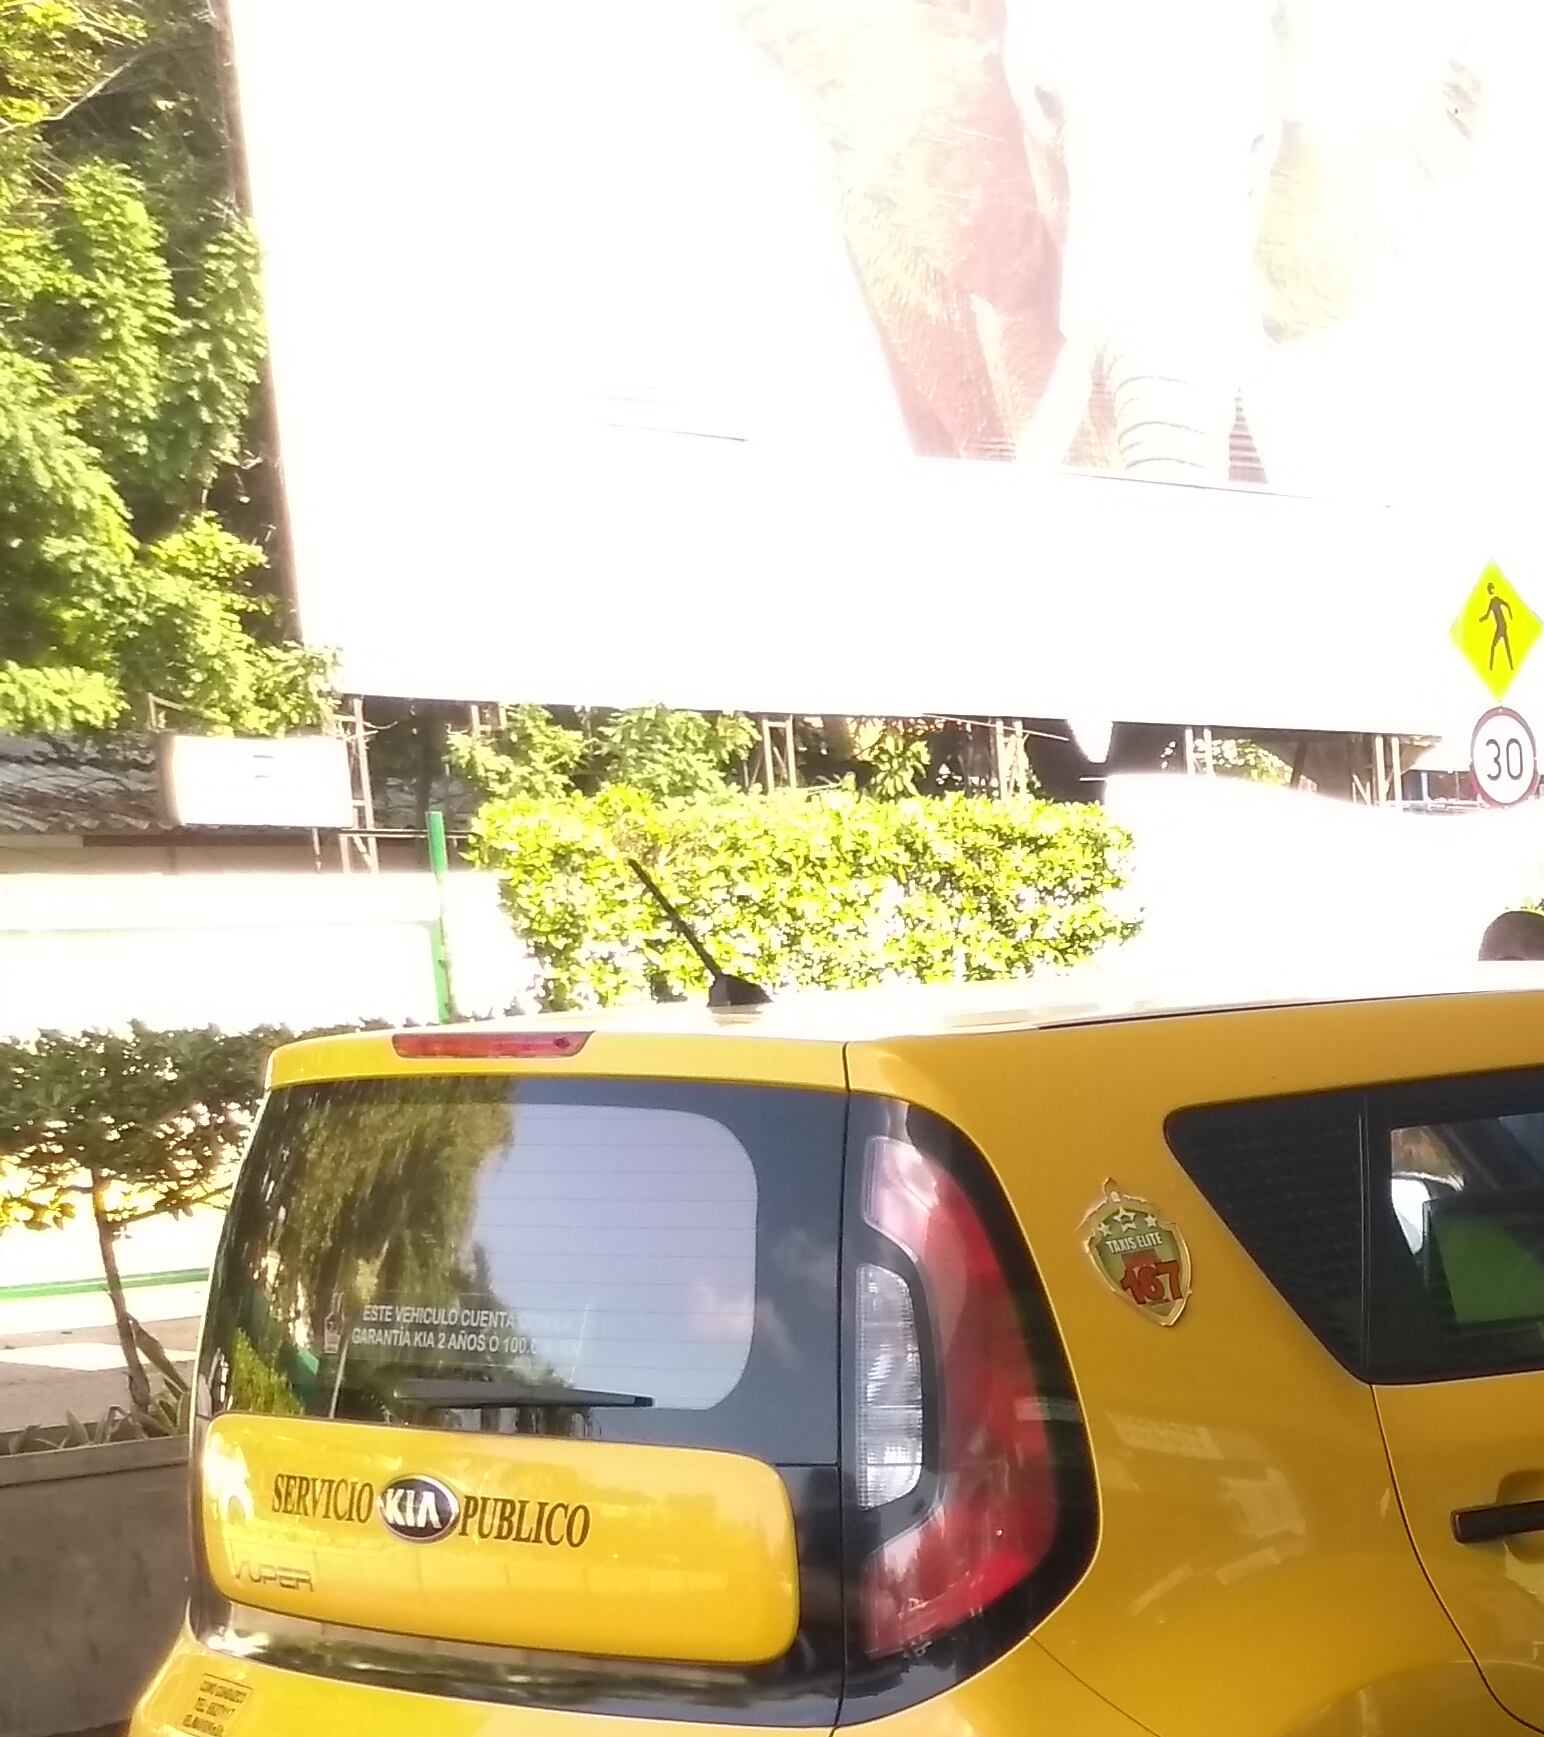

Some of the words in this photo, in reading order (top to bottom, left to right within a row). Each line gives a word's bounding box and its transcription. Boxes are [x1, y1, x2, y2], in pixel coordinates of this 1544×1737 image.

[1486, 738, 1523, 780] 30
[1106, 1237, 1138, 1253] TAXIS
[1135, 1231, 1163, 1249] ELITE
[1120, 1260, 1184, 1305] 167
[362, 1304, 394, 1324] ESTE
[395, 1306, 458, 1326] VEHICULO
[460, 1309, 515, 1329] CUENTA
[352, 1325, 411, 1347] GARANTÍA
[412, 1331, 436, 1349] KIA
[437, 1332, 446, 1349] 2
[447, 1330, 486, 1351] AÑOS
[272, 1473, 375, 1524] SERVICIO
[382, 1487, 443, 1530] KIA
[458, 1495, 592, 1549] PUBLICO
